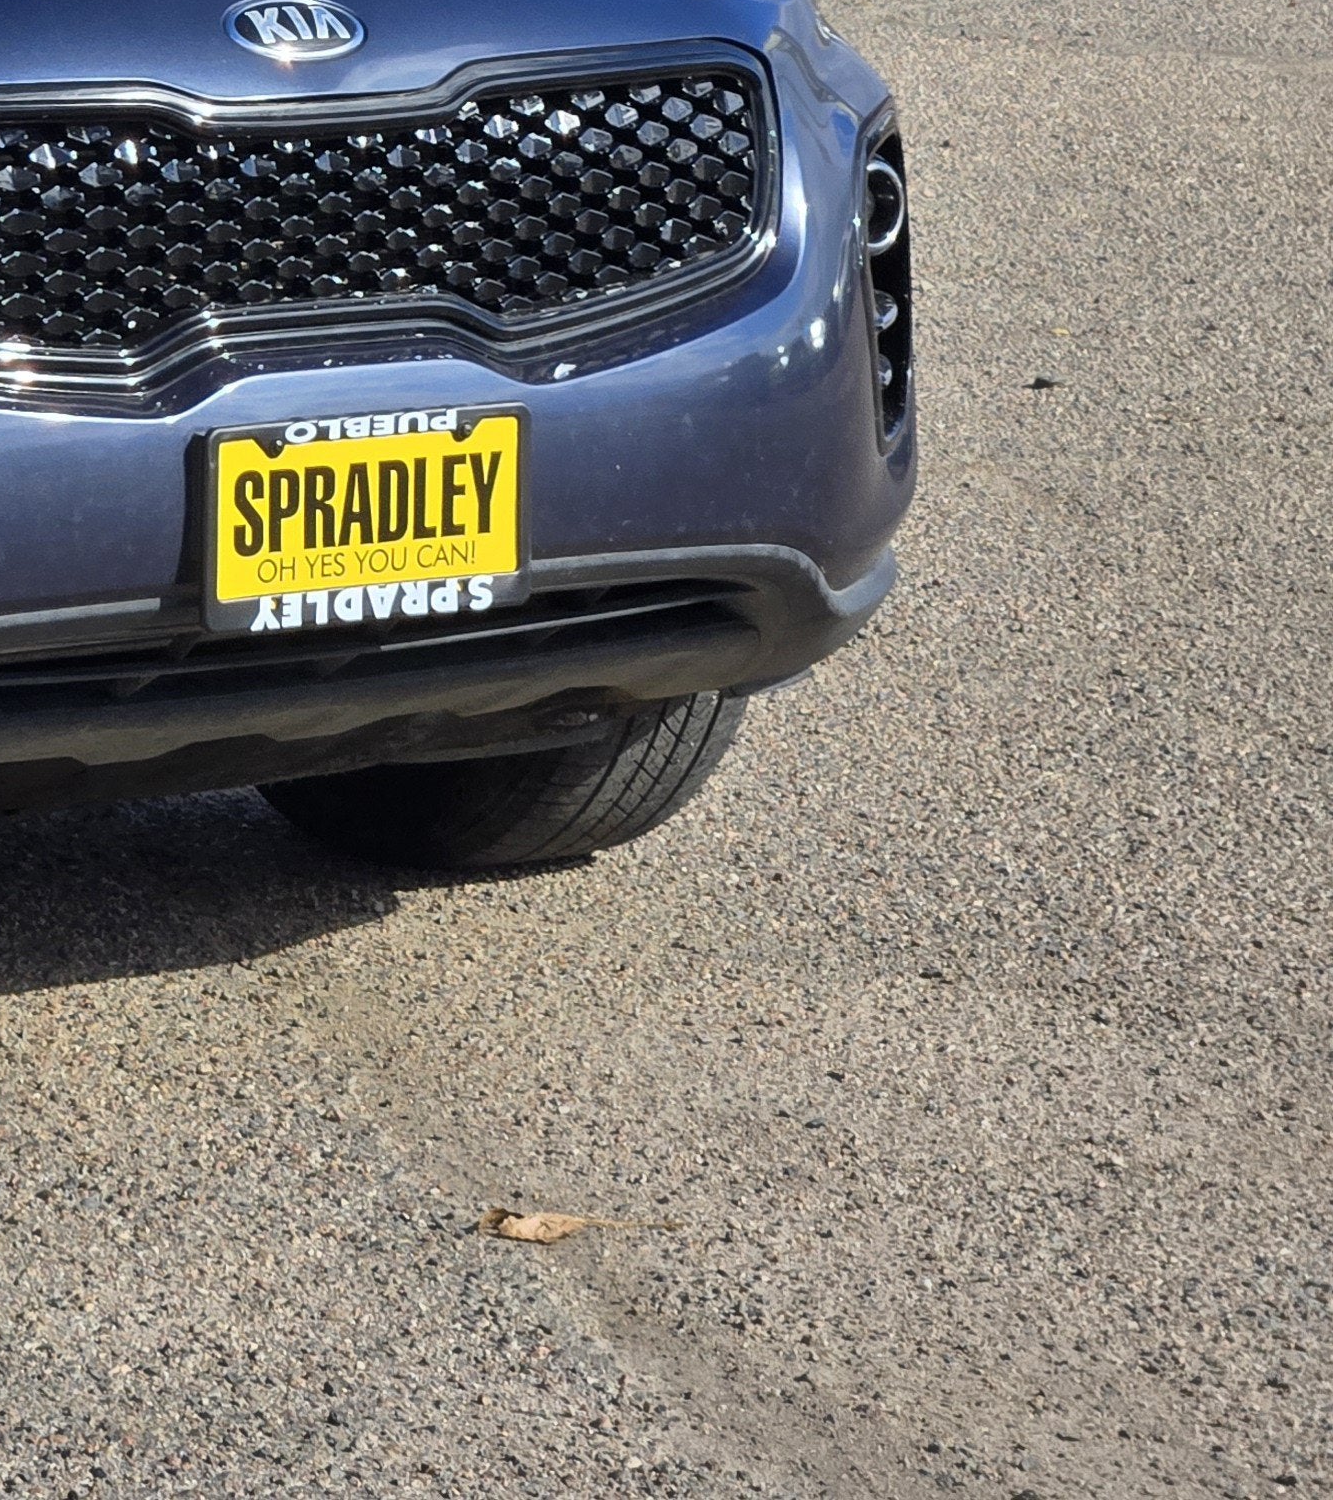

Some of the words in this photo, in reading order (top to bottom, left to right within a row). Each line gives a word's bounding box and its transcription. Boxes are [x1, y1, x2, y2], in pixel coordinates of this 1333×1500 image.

[244, 6, 351, 44] KIA
[284, 408, 458, 444] PUEBLO
[233, 451, 503, 558] SPRADLEY
[257, 558, 296, 583] OH
[305, 553, 345, 579] YES
[355, 547, 407, 575] YOU
[417, 541, 476, 569] CAN!
[250, 575, 494, 632] SPRADLEY
